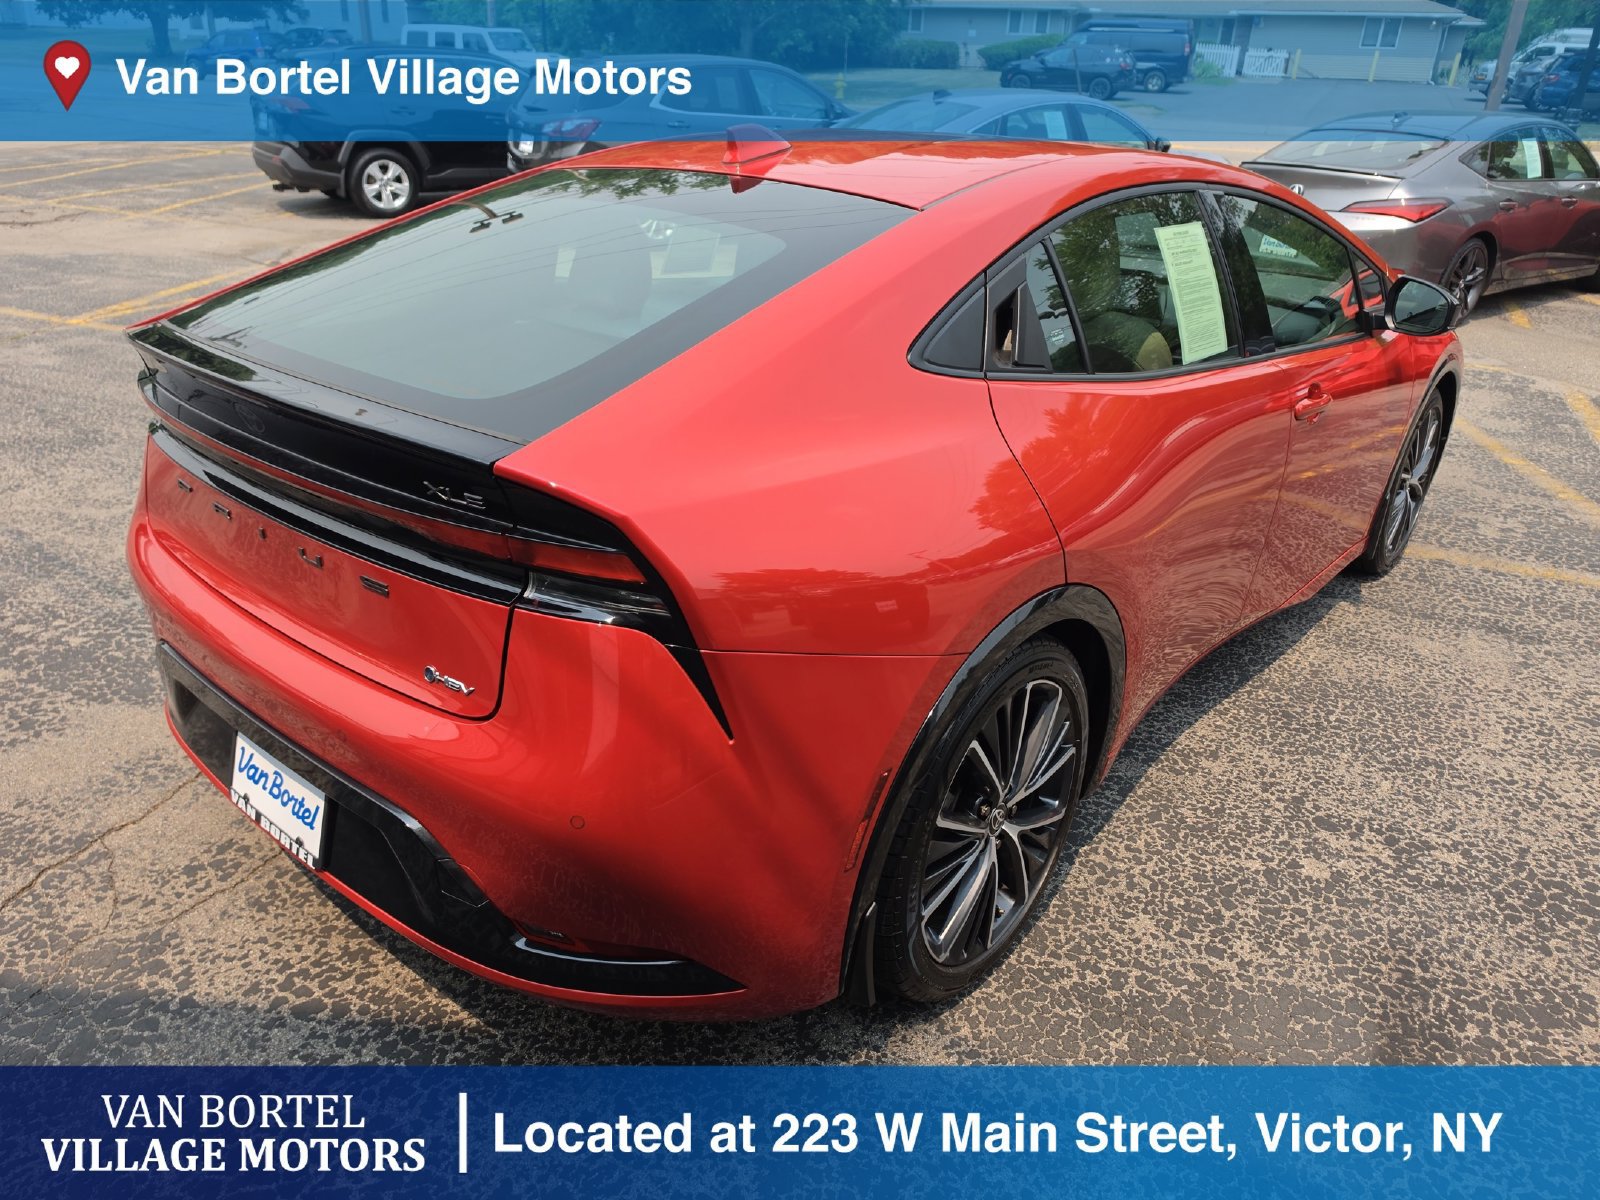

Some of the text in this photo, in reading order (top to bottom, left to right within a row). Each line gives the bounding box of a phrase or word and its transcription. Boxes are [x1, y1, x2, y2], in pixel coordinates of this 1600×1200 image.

[423, 481, 486, 509] XLE
[434, 671, 475, 696] HEV
[230, 787, 316, 871] VAN BORTEL
